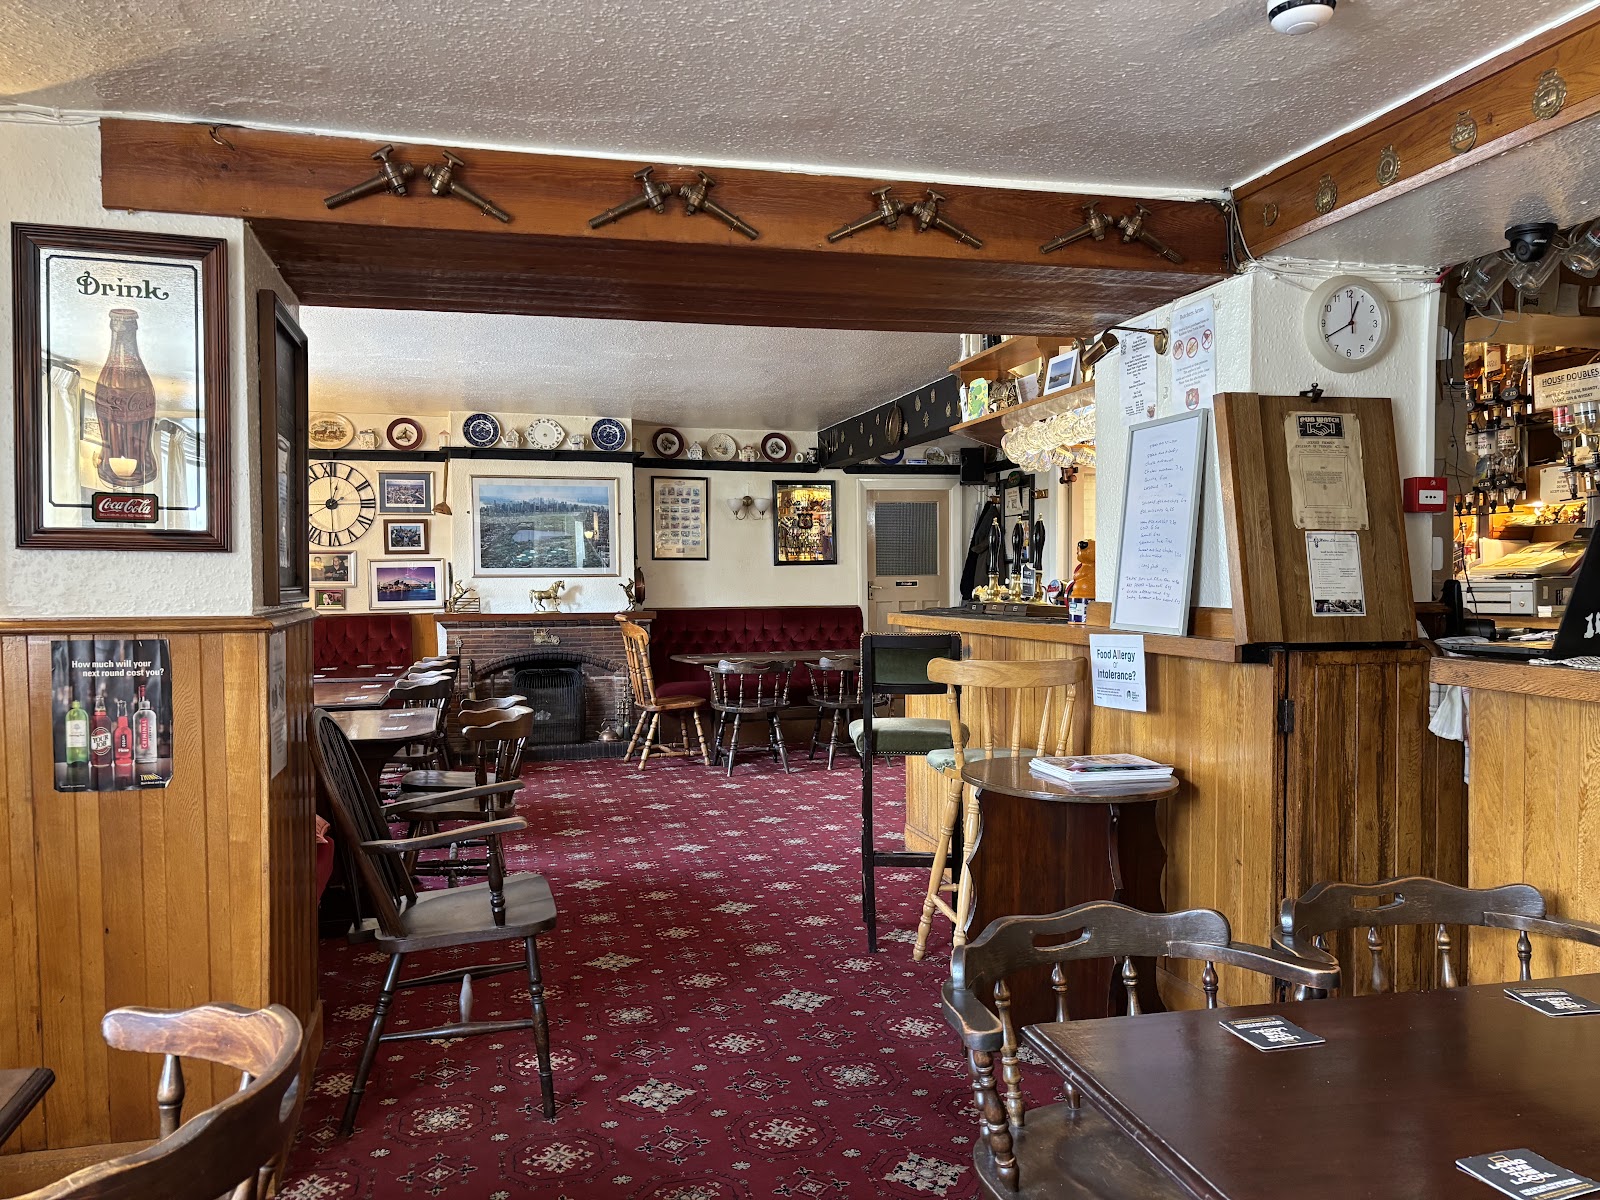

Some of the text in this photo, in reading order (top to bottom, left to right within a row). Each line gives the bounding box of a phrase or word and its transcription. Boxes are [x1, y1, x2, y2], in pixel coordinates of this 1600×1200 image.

[76, 271, 169, 301] Drink
[1345, 290, 1353, 298] 12
[1333, 295, 1341, 303] 11
[1360, 295, 1365, 303] 1
[1324, 305, 1332, 313] 10
[1369, 305, 1375, 313] 2
[1321, 319, 1326, 328] 9
[1373, 320, 1378, 328] 3
[1368, 334, 1374, 342] 4
[1334, 345, 1339, 353] 7
[1346, 349, 1352, 357] 6
[1359, 345, 1365, 353] 5
[1542, 375, 1565, 387] HOUSE
[1566, 368, 1600, 381] DOUBLES
[98, 497, 152, 514] Coca-Cola
[1097, 648, 1136, 663] Food Allergy
[71, 660, 91, 668] How
[92, 660, 114, 668] much
[133, 660, 152, 669] your
[82, 668, 165, 677] next round cost you?
[1098, 669, 1137, 681] Intolerance?
[92, 734, 109, 744] YOUR
[95, 741, 107, 750] JOB
[1487, 1158, 1528, 1170] LONG
[1510, 1172, 1558, 1185] LOCAL
